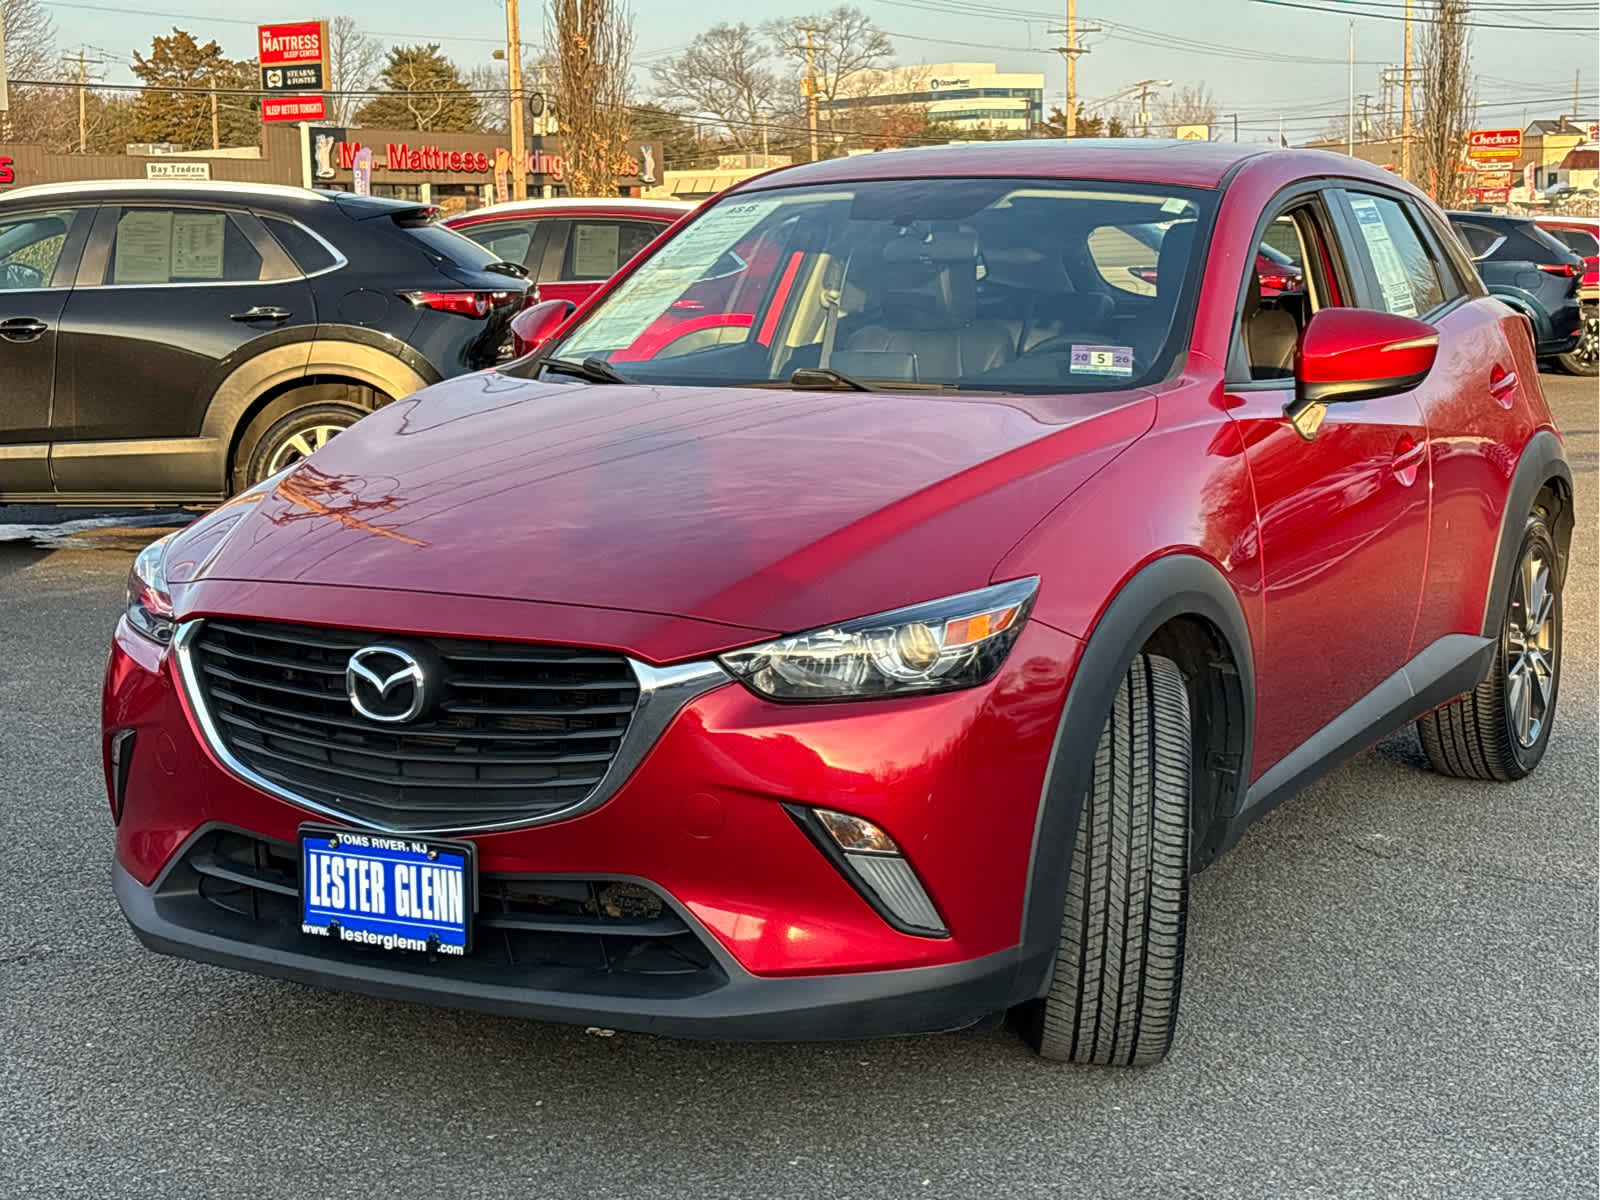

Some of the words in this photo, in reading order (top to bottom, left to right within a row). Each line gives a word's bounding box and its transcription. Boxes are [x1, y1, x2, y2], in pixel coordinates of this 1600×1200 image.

[262, 34, 319, 52] MATTRESS
[265, 105, 281, 116] SLEEP
[1471, 133, 1519, 145] Checkers
[338, 142, 379, 169] M.
[386, 143, 489, 171] Mattress
[151, 165, 168, 176] Bay
[1097, 353, 1105, 364] 5
[336, 833, 371, 847] TOMS
[372, 838, 410, 852] RIVER,
[412, 843, 428, 854] NJ
[309, 853, 386, 915] LESTER
[394, 864, 464, 924] GLENN
[301, 924, 330, 936] www.
[340, 927, 427, 951] lesterglenn
[437, 944, 464, 956] .com
